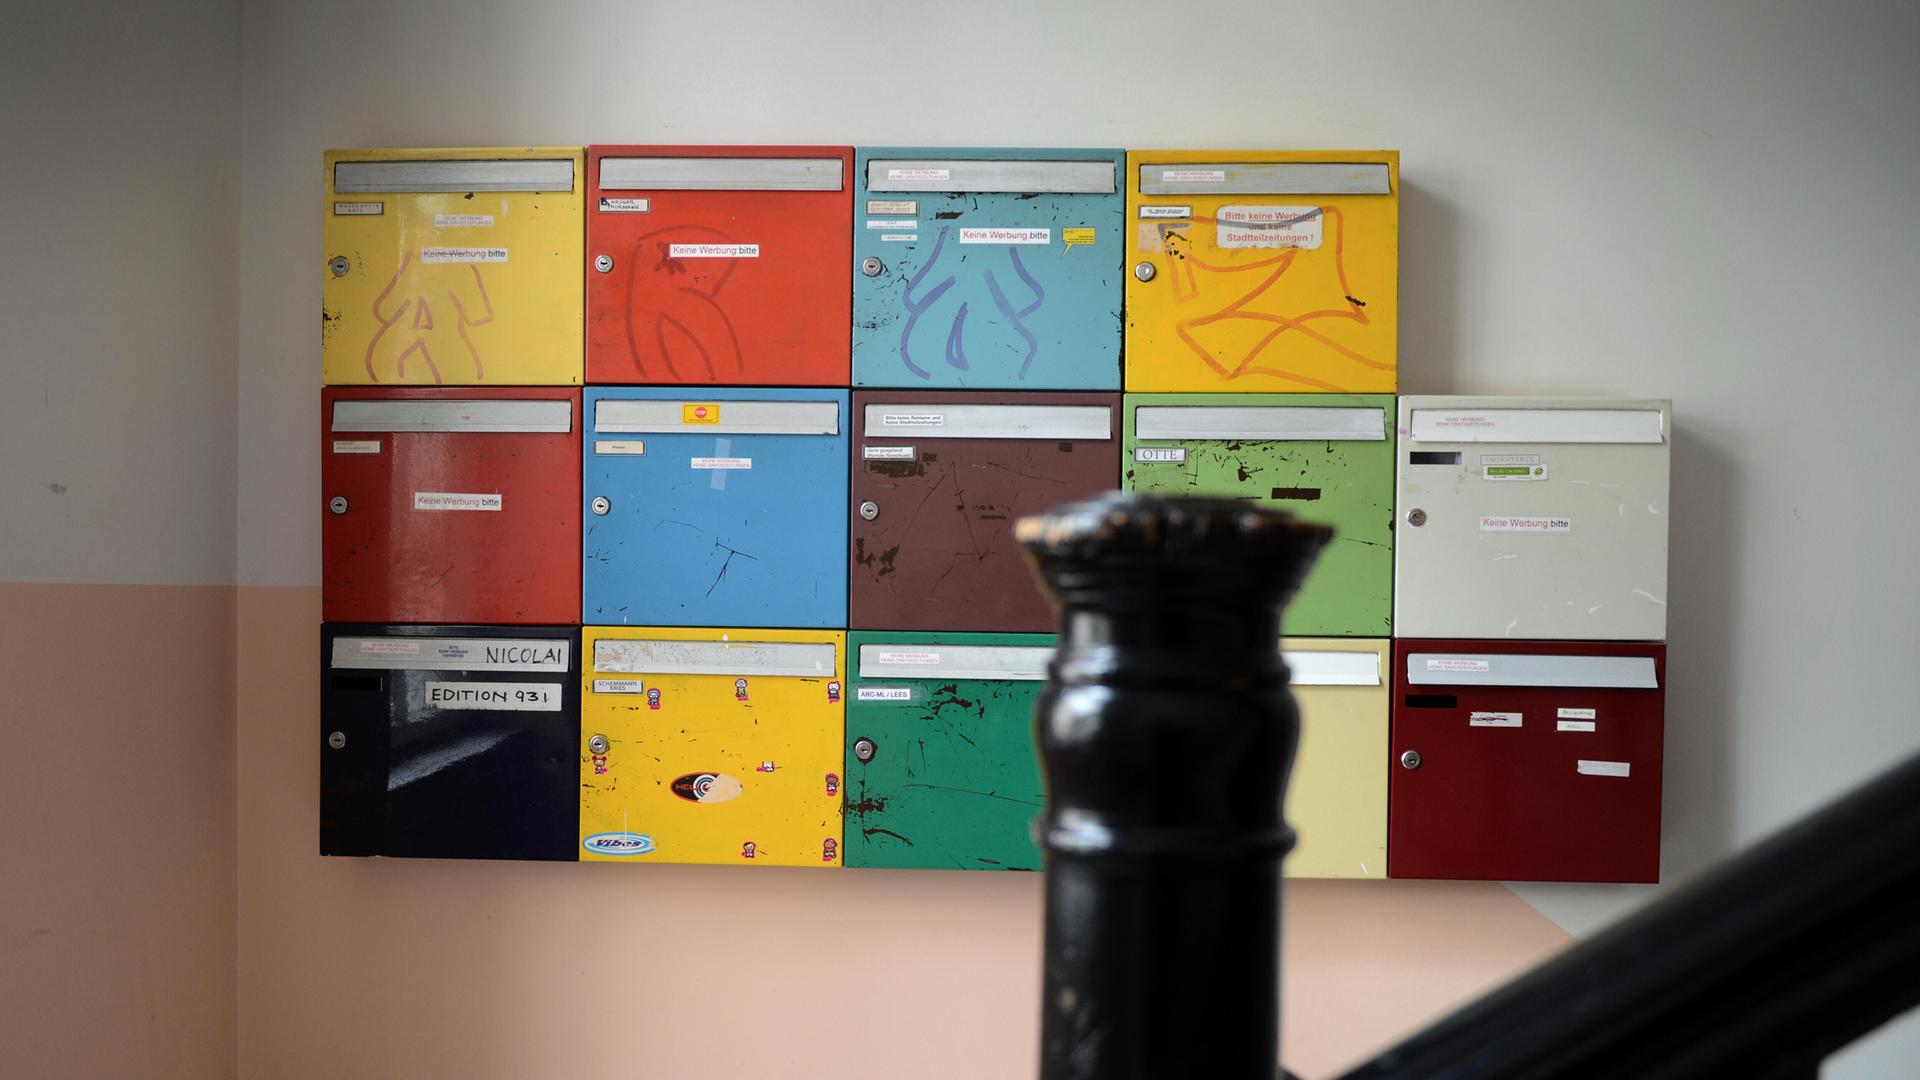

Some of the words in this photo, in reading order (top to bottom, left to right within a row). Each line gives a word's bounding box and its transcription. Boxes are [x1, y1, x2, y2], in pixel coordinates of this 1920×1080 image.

[1225, 212, 1246, 220] Bitte
[1248, 212, 1273, 220] keine
[1275, 212, 1316, 222] Werbung
[1268, 223, 1293, 231] keine
[963, 230, 987, 239] Keine
[990, 231, 1027, 240] Werbung
[1029, 231, 1048, 239] bitte
[1227, 233, 1308, 243] Stadtteilzeitungen
[423, 249, 446, 258] Keine
[449, 249, 486, 259] Werbung
[488, 249, 506, 257] bitte
[673, 246, 697, 254] Keine
[699, 246, 736, 256] Werbung
[739, 246, 757, 254] bitte
[1143, 449, 1177, 460] OTTE
[417, 496, 441, 504] Keine
[443, 497, 480, 507] Werbung
[482, 498, 499, 506] bitte
[1483, 518, 1508, 527] Keine
[1510, 519, 1548, 529] Werbung
[1551, 519, 1569, 528] bitte
[486, 646, 561, 664] NICOLAI
[432, 688, 507, 702] EDITION
[515, 690, 547, 703] 931
